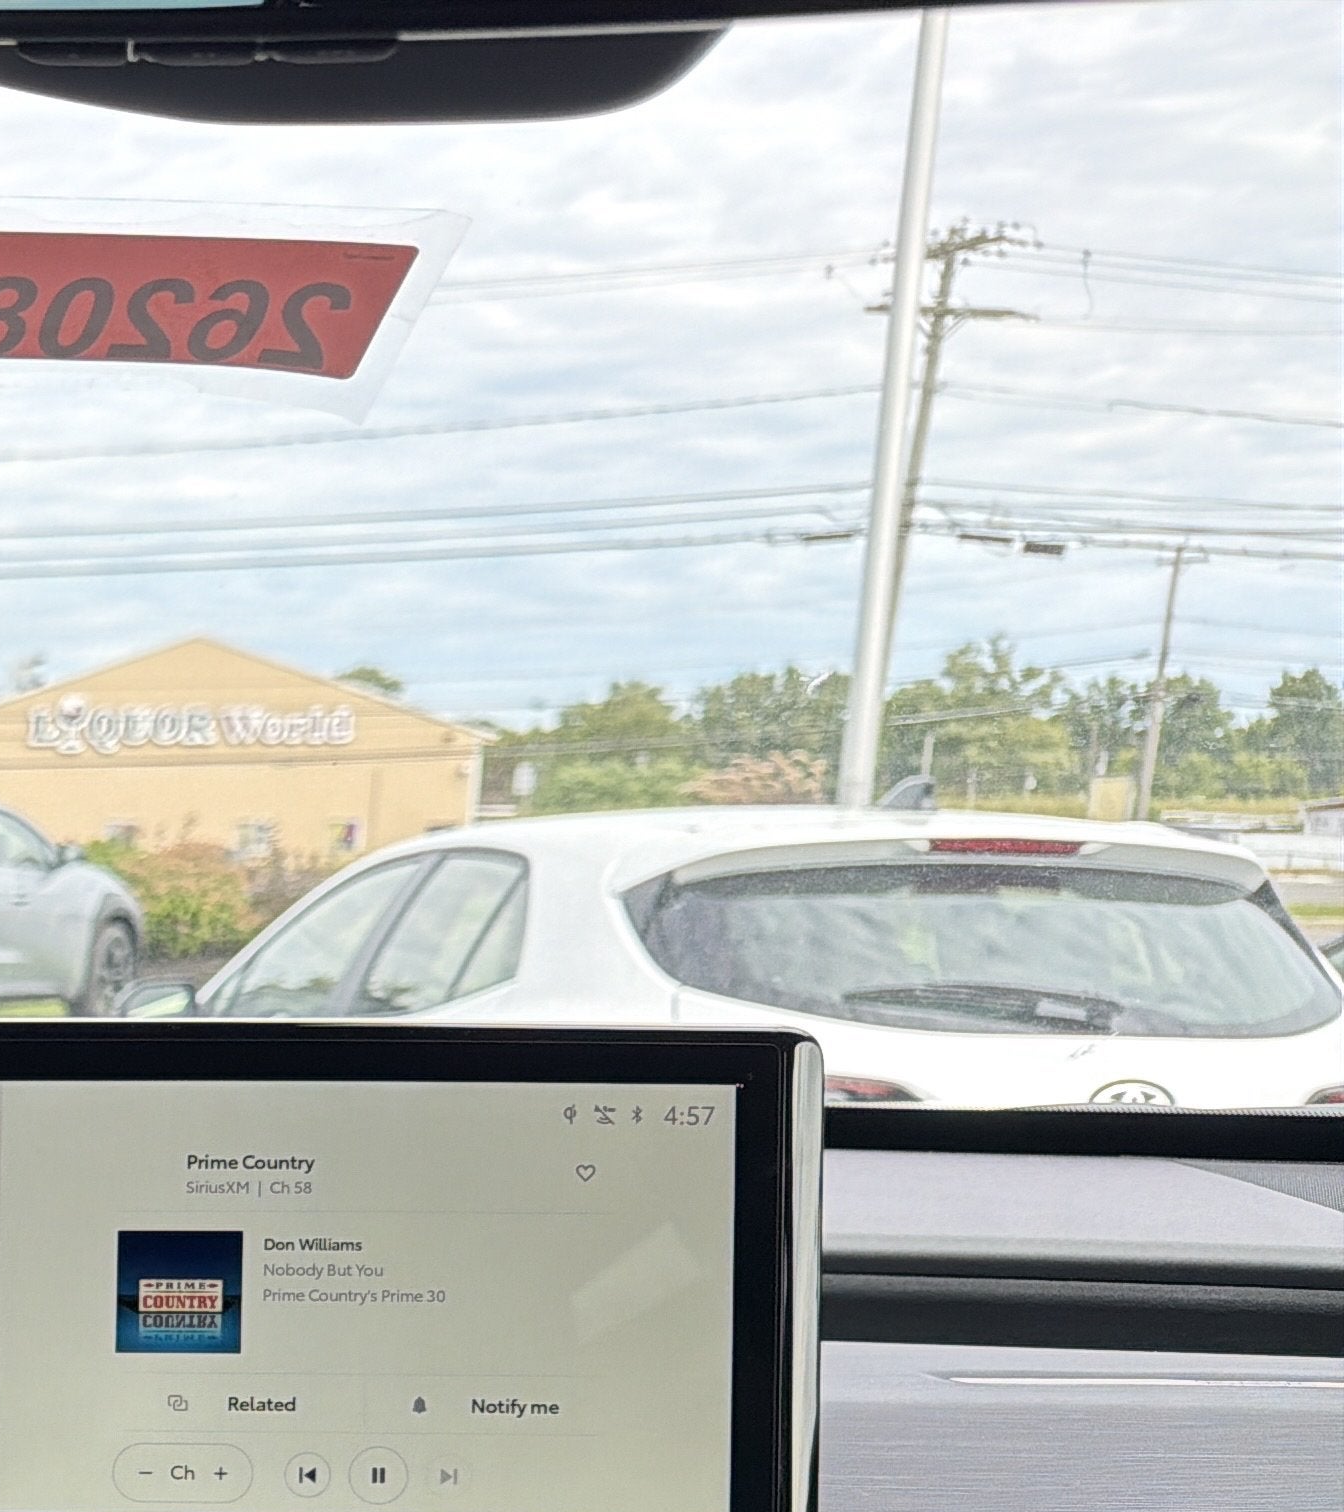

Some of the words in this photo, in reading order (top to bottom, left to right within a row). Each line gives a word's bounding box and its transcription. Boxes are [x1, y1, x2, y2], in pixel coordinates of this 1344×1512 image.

[220, 704, 355, 746] World
[664, 1105, 716, 1126] 4:57
[186, 1154, 239, 1171] Prime
[242, 1154, 316, 1174] Country
[185, 1180, 250, 1195] SiriusXM
[269, 1180, 291, 1195] Ch
[294, 1180, 313, 1195] 58
[263, 1238, 295, 1252] Don
[298, 1237, 363, 1252] Williams
[263, 1263, 324, 1280] Nobody
[327, 1263, 353, 1277] But
[355, 1263, 385, 1277] You
[155, 1282, 207, 1290] PRIME
[142, 1295, 219, 1309] COUNTRY
[262, 1288, 308, 1303] Prime
[311, 1288, 378, 1306] Country's
[380, 1288, 424, 1303] Prime
[426, 1289, 446, 1303] 30
[227, 1396, 297, 1412] Related
[471, 1398, 527, 1418] Notify
[530, 1401, 559, 1415] me
[170, 1464, 195, 1481] Ch
